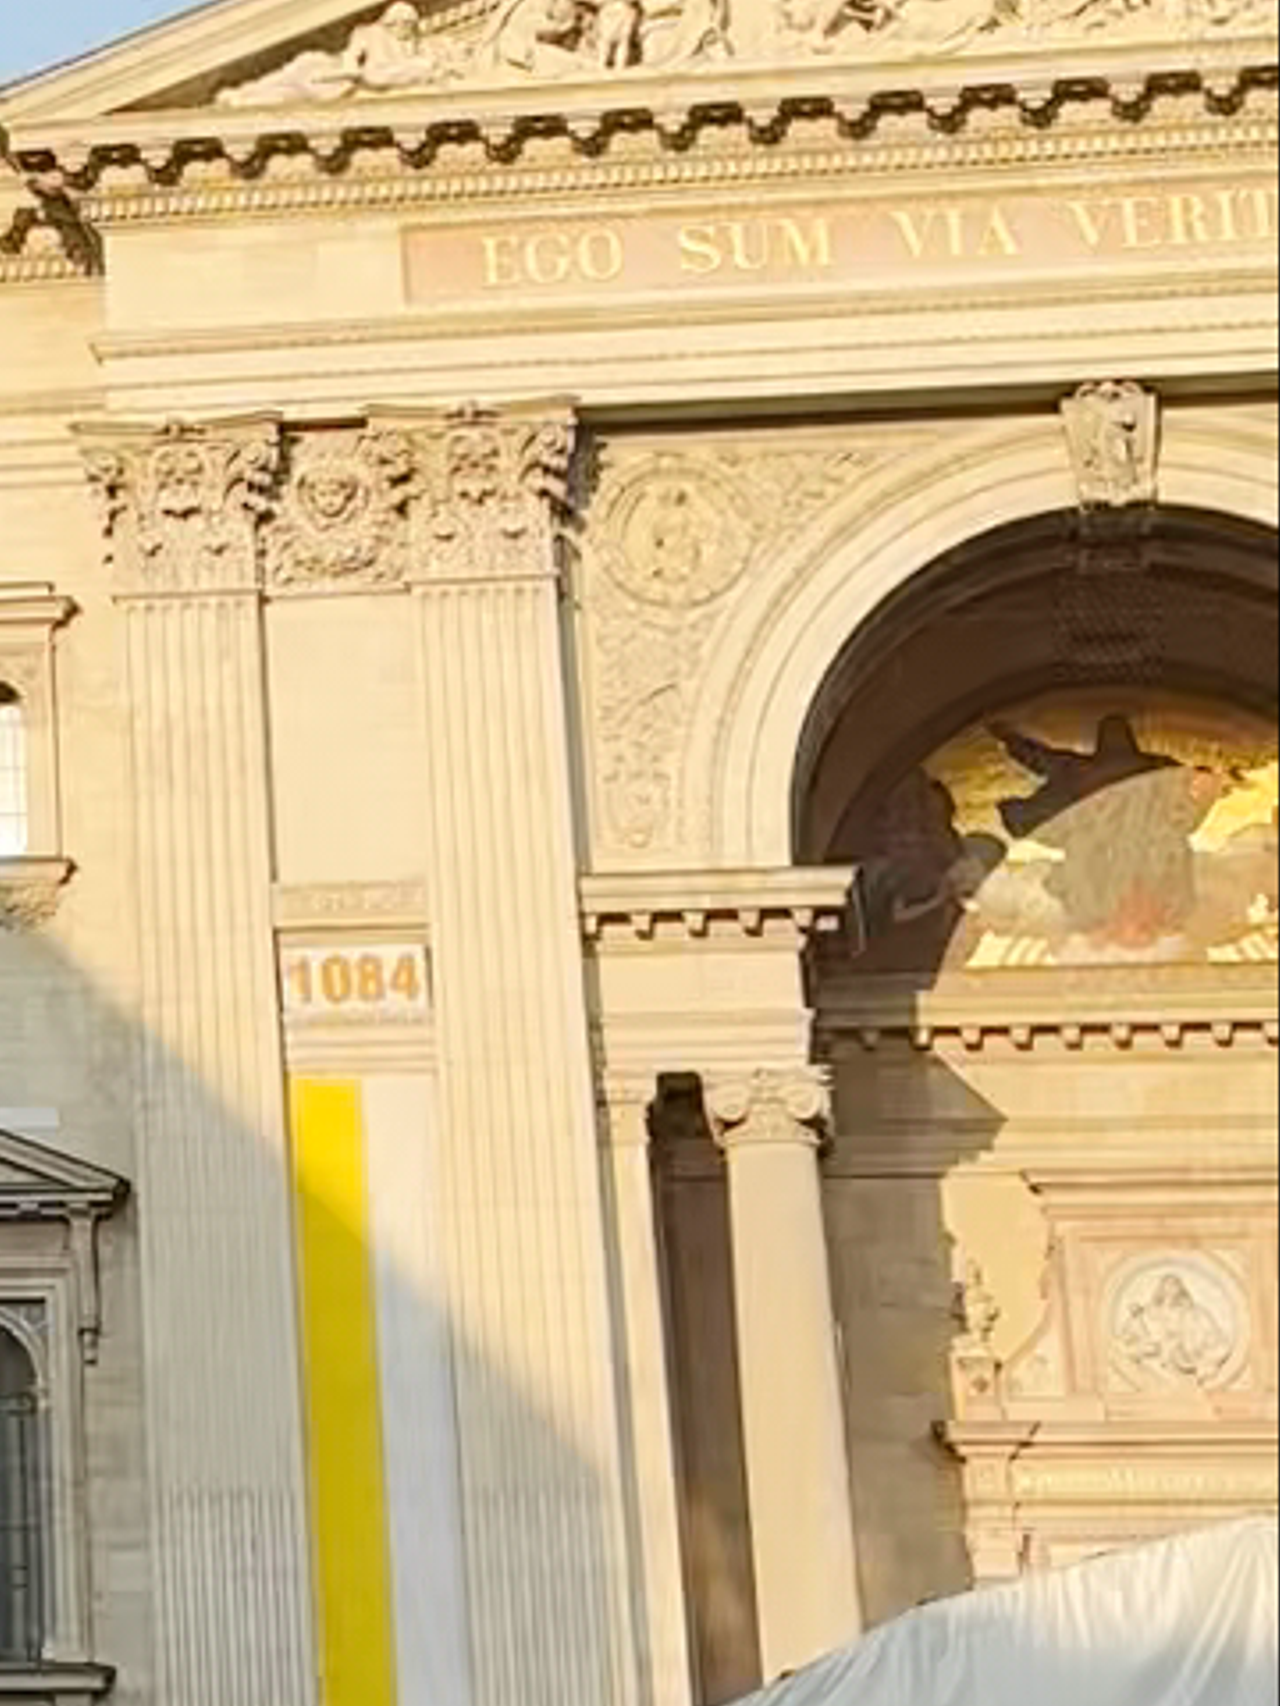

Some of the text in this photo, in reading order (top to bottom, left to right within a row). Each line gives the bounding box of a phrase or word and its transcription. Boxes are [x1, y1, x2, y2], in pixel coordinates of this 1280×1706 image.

[480, 227, 624, 288] EGO
[676, 217, 834, 274] SUM
[890, 203, 1021, 259] VIA
[286, 952, 422, 1004] 1084
